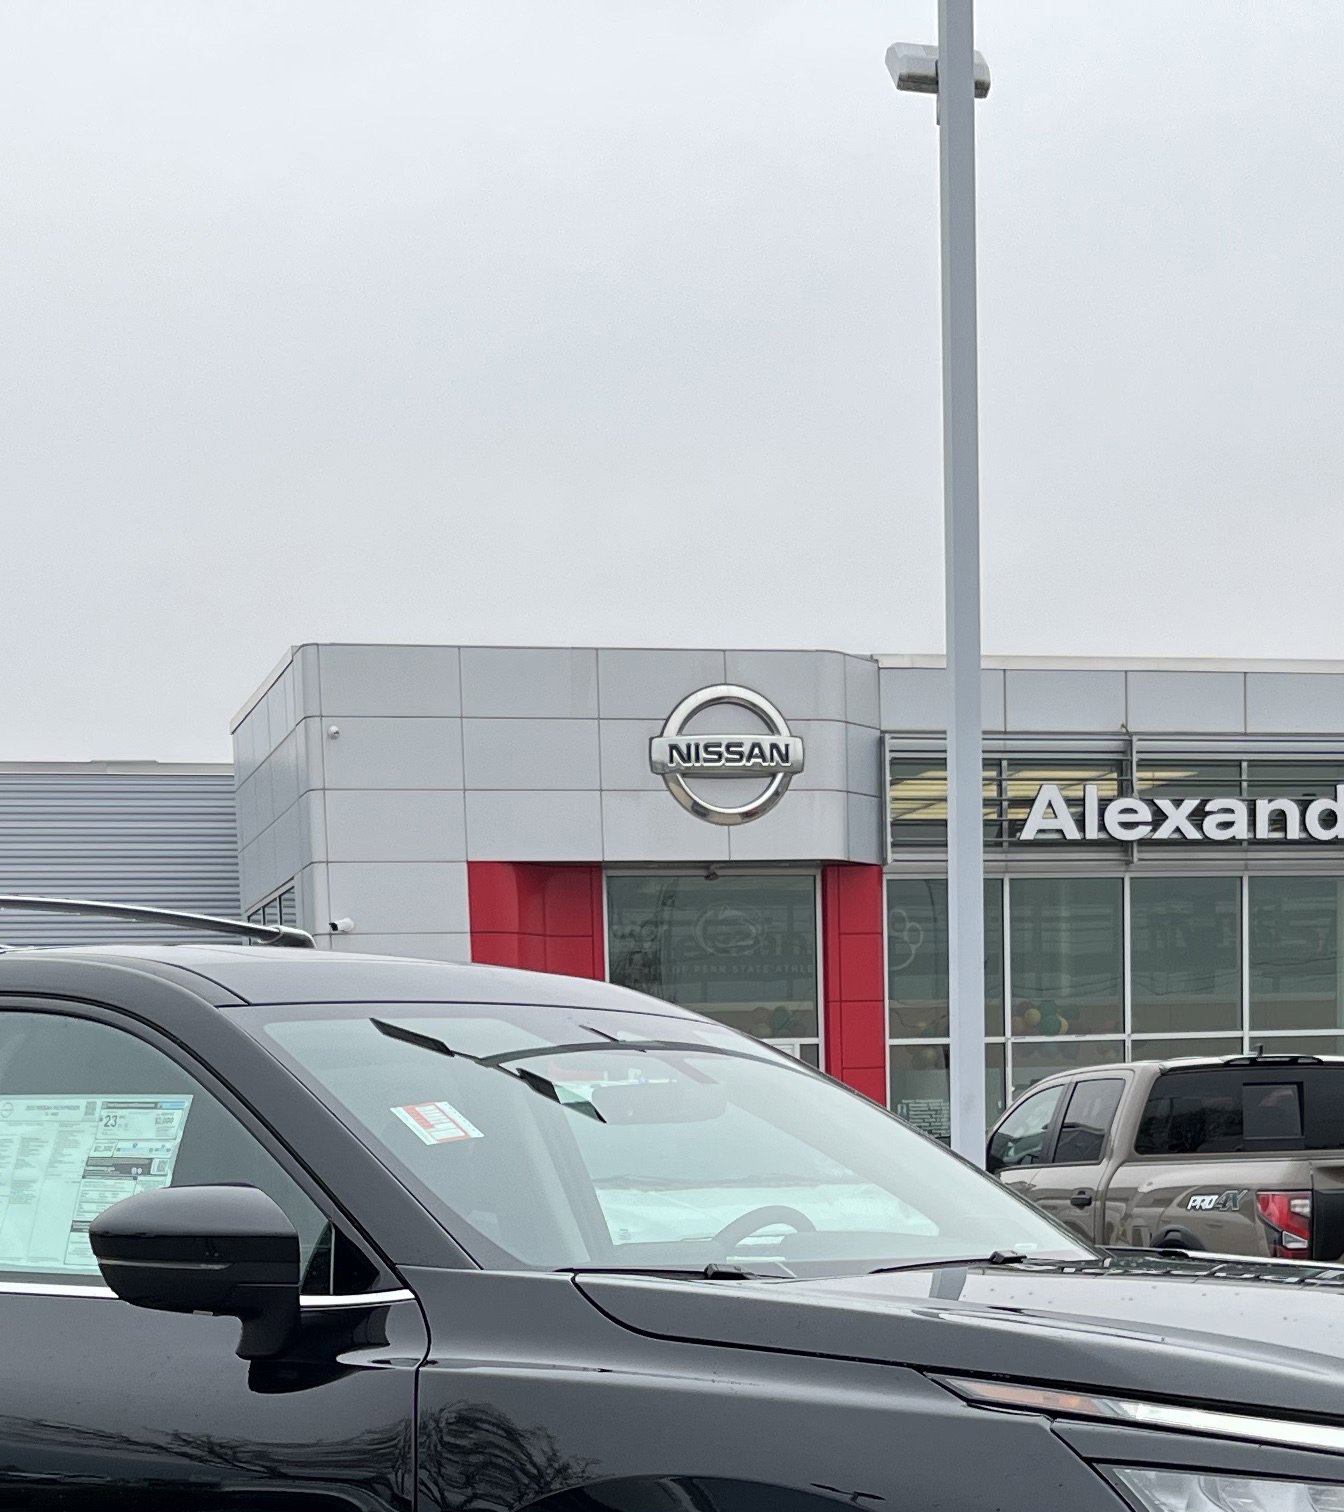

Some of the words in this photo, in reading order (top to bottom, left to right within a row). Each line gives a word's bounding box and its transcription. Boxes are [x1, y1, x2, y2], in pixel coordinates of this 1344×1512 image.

[667, 741, 791, 767] NISSAN
[694, 964, 726, 974] PENN
[732, 964, 769, 974] STATE
